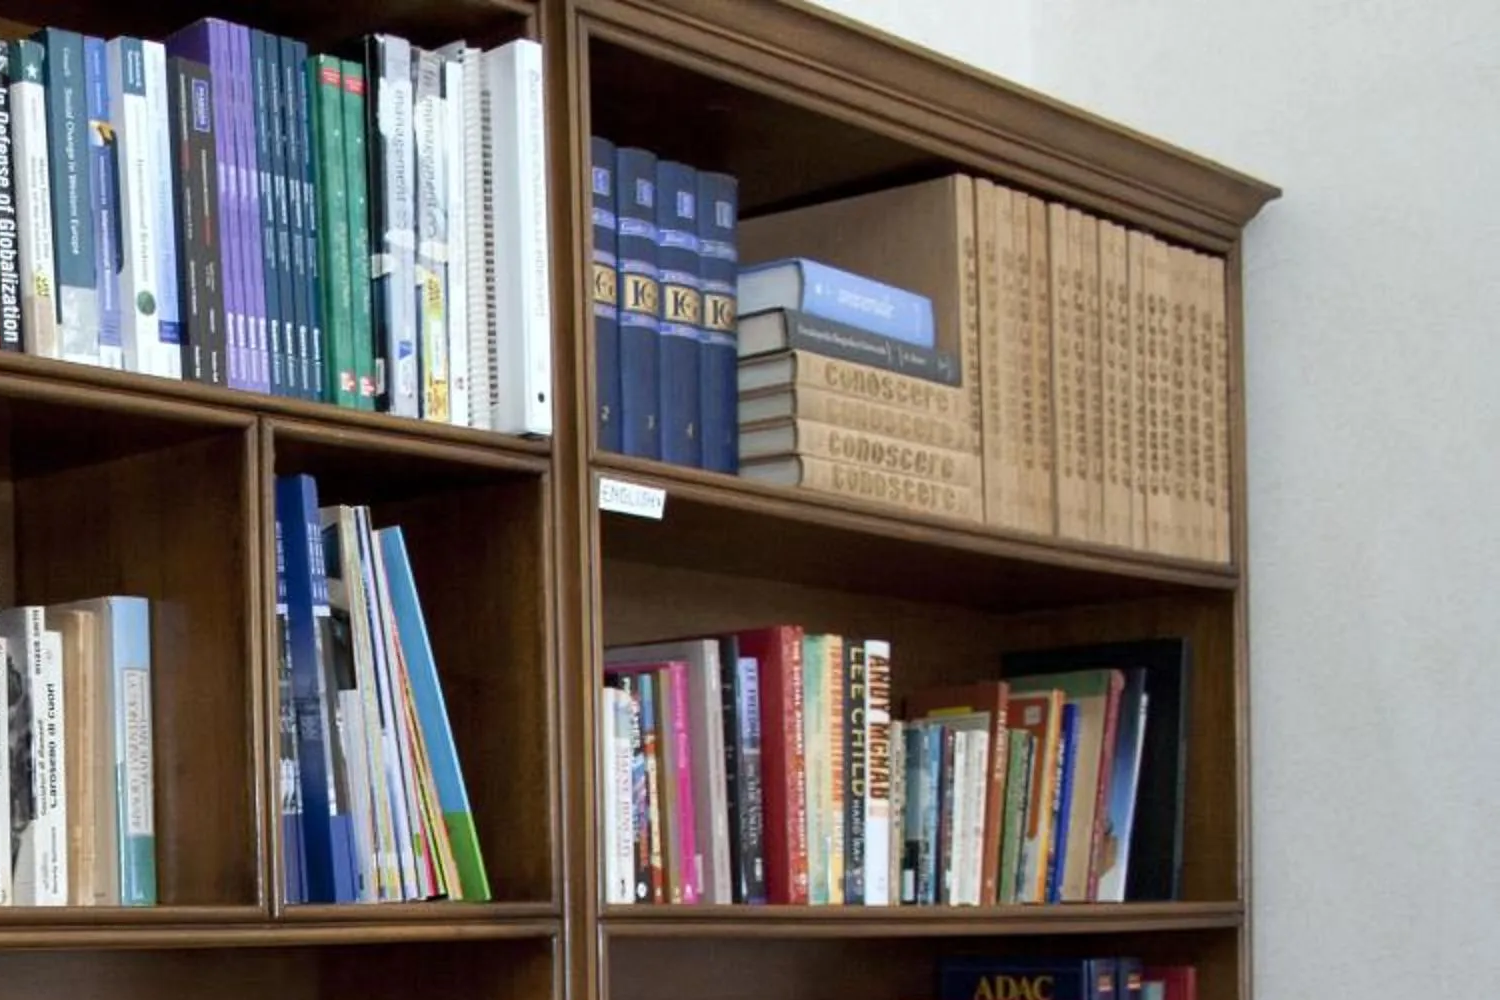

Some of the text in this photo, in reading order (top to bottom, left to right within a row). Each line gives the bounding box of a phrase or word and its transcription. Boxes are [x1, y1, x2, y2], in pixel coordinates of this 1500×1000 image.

[64, 87, 74, 120] Social
[65, 122, 76, 159] Change
[67, 161, 76, 171] in
[69, 220, 81, 255] Europe
[869, 655, 891, 714] ANDY
[851, 647, 865, 796] LEE CHILD
